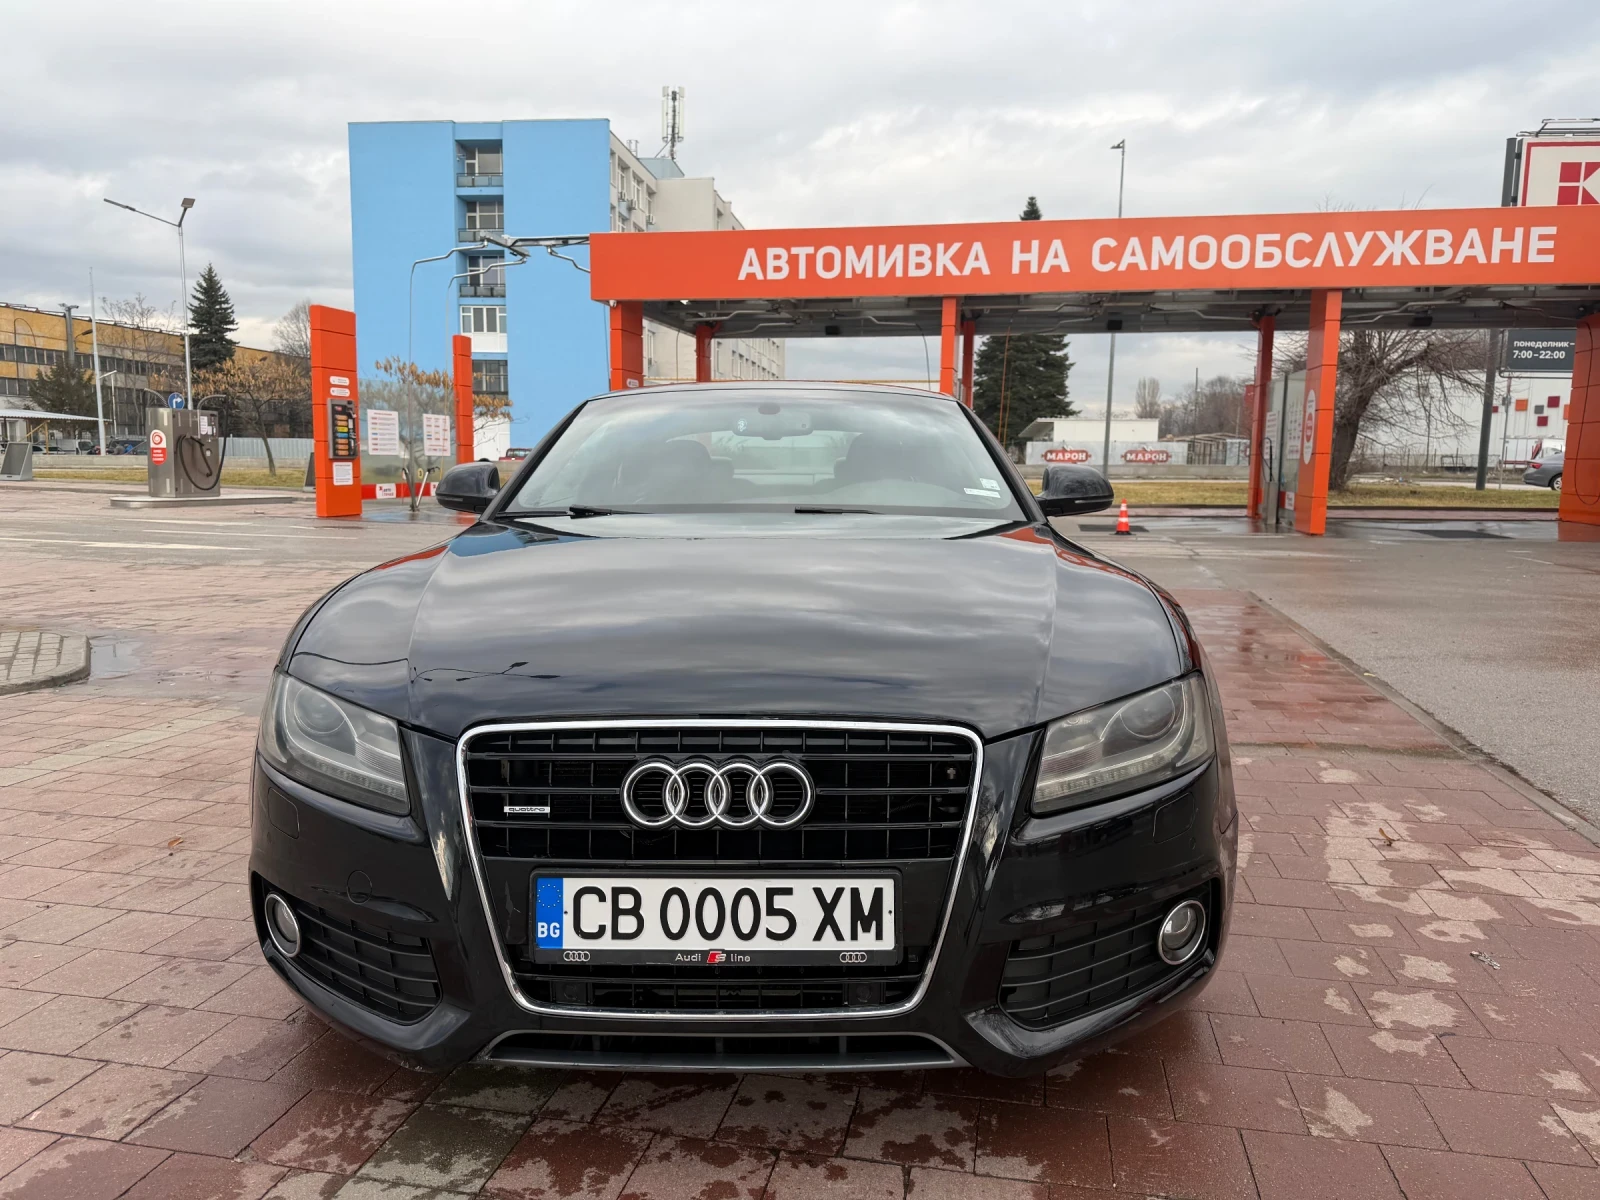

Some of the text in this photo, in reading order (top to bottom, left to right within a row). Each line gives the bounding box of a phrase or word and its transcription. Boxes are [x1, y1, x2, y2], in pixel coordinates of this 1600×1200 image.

[737, 226, 1558, 281] АВТОМИВКА НА САМООБСЛУЖВАНЕ
[1046, 452, 1087, 461] МАРОН
[1126, 452, 1167, 461] МАРОН
[572, 886, 884, 942] CB 0005 XM
[537, 921, 561, 938] BG
[674, 953, 702, 962] Audi
[730, 953, 751, 962] line
